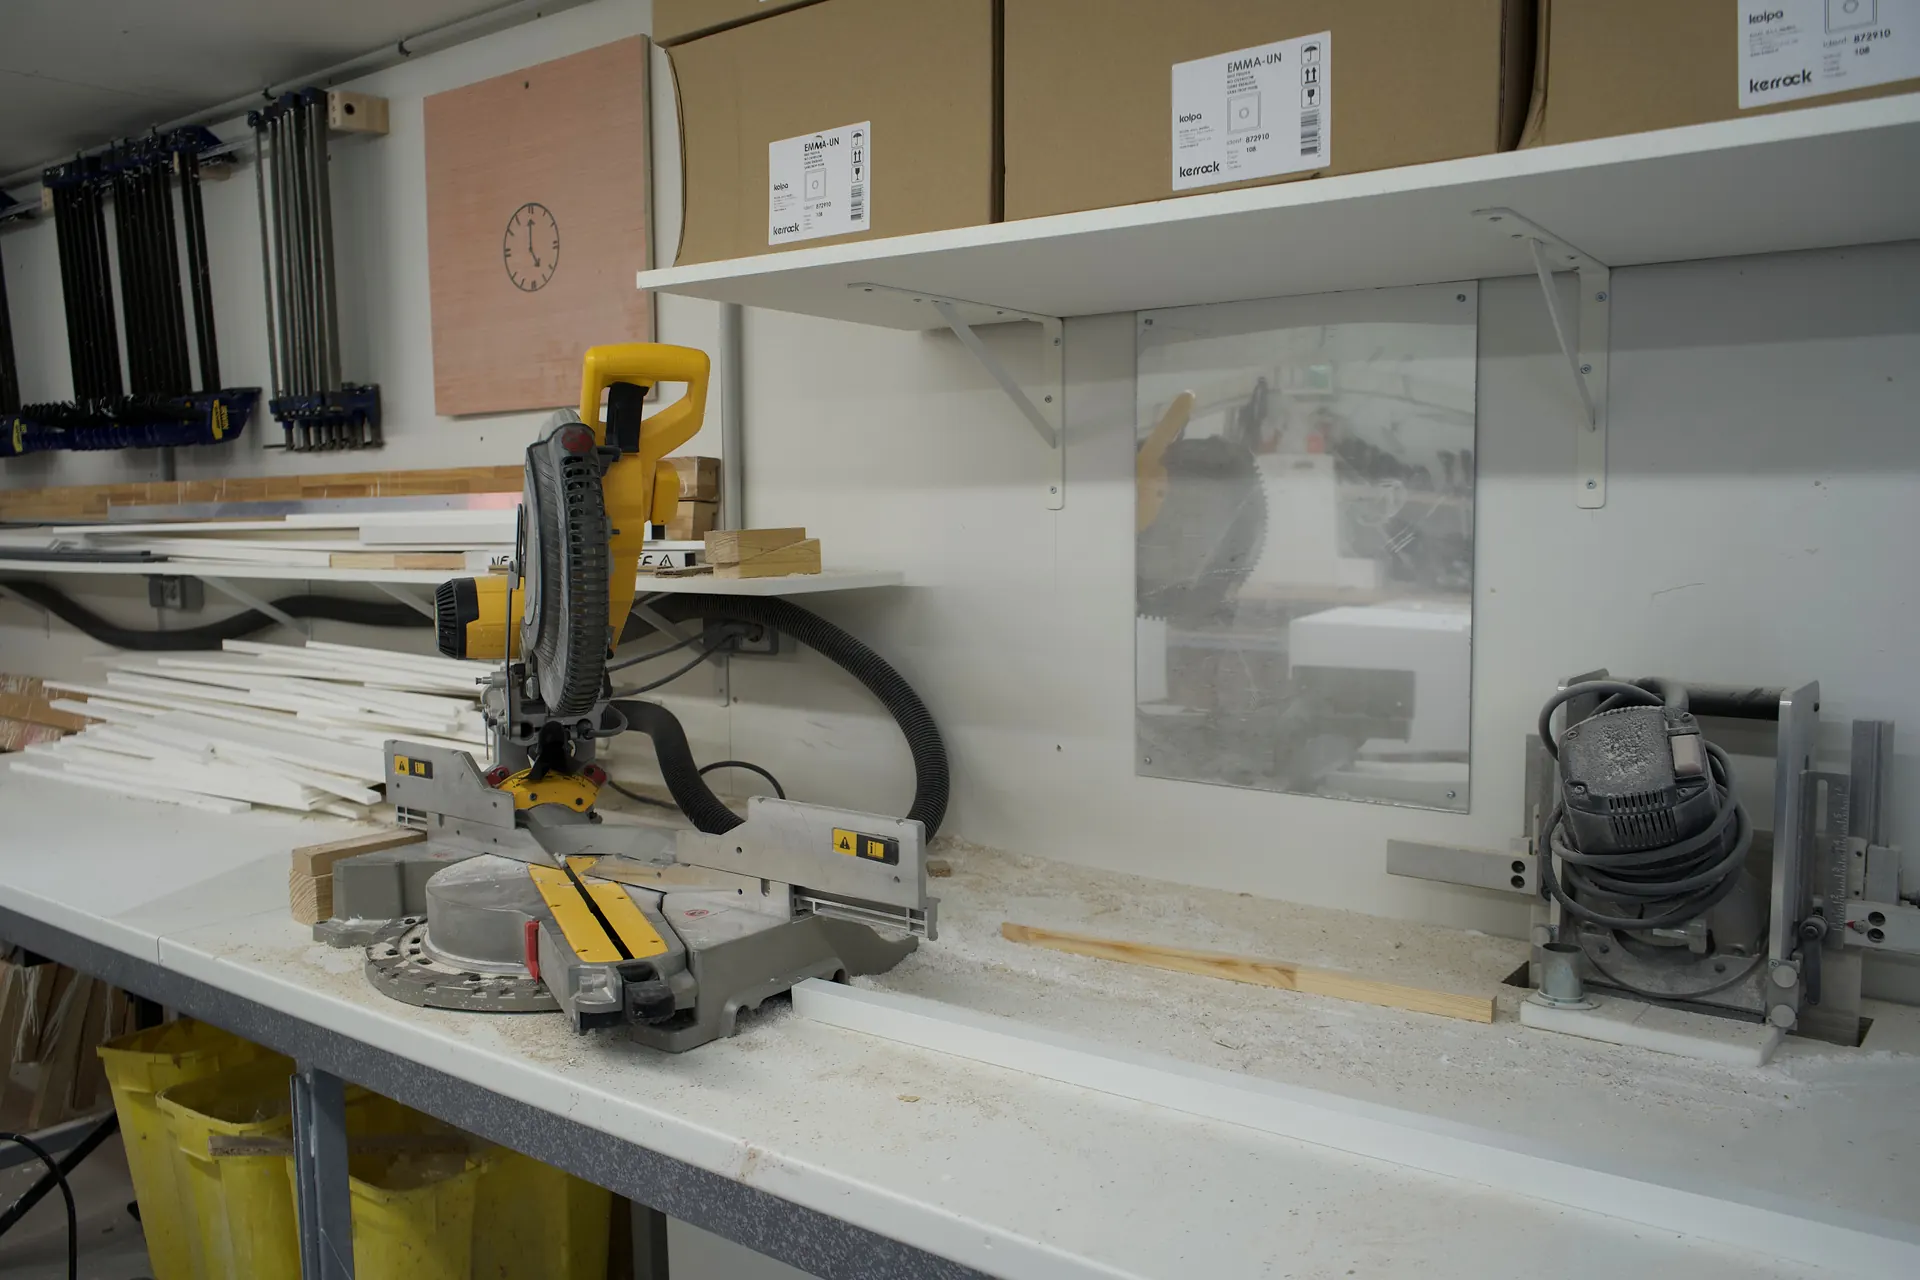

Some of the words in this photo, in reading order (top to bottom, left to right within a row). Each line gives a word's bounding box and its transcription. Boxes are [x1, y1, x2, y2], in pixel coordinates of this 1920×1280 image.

[1749, 9, 1784, 25] kolpa
[1853, 28, 1891, 44] 872910
[1227, 52, 1282, 73] EMMA-UN
[1749, 68, 1813, 94] kerrock
[1179, 112, 1202, 123] kolpa
[804, 137, 840, 152] EMMA-UN
[1245, 133, 1270, 144] 872910
[1179, 161, 1220, 178] kerrock
[773, 222, 800, 236] kerrock
